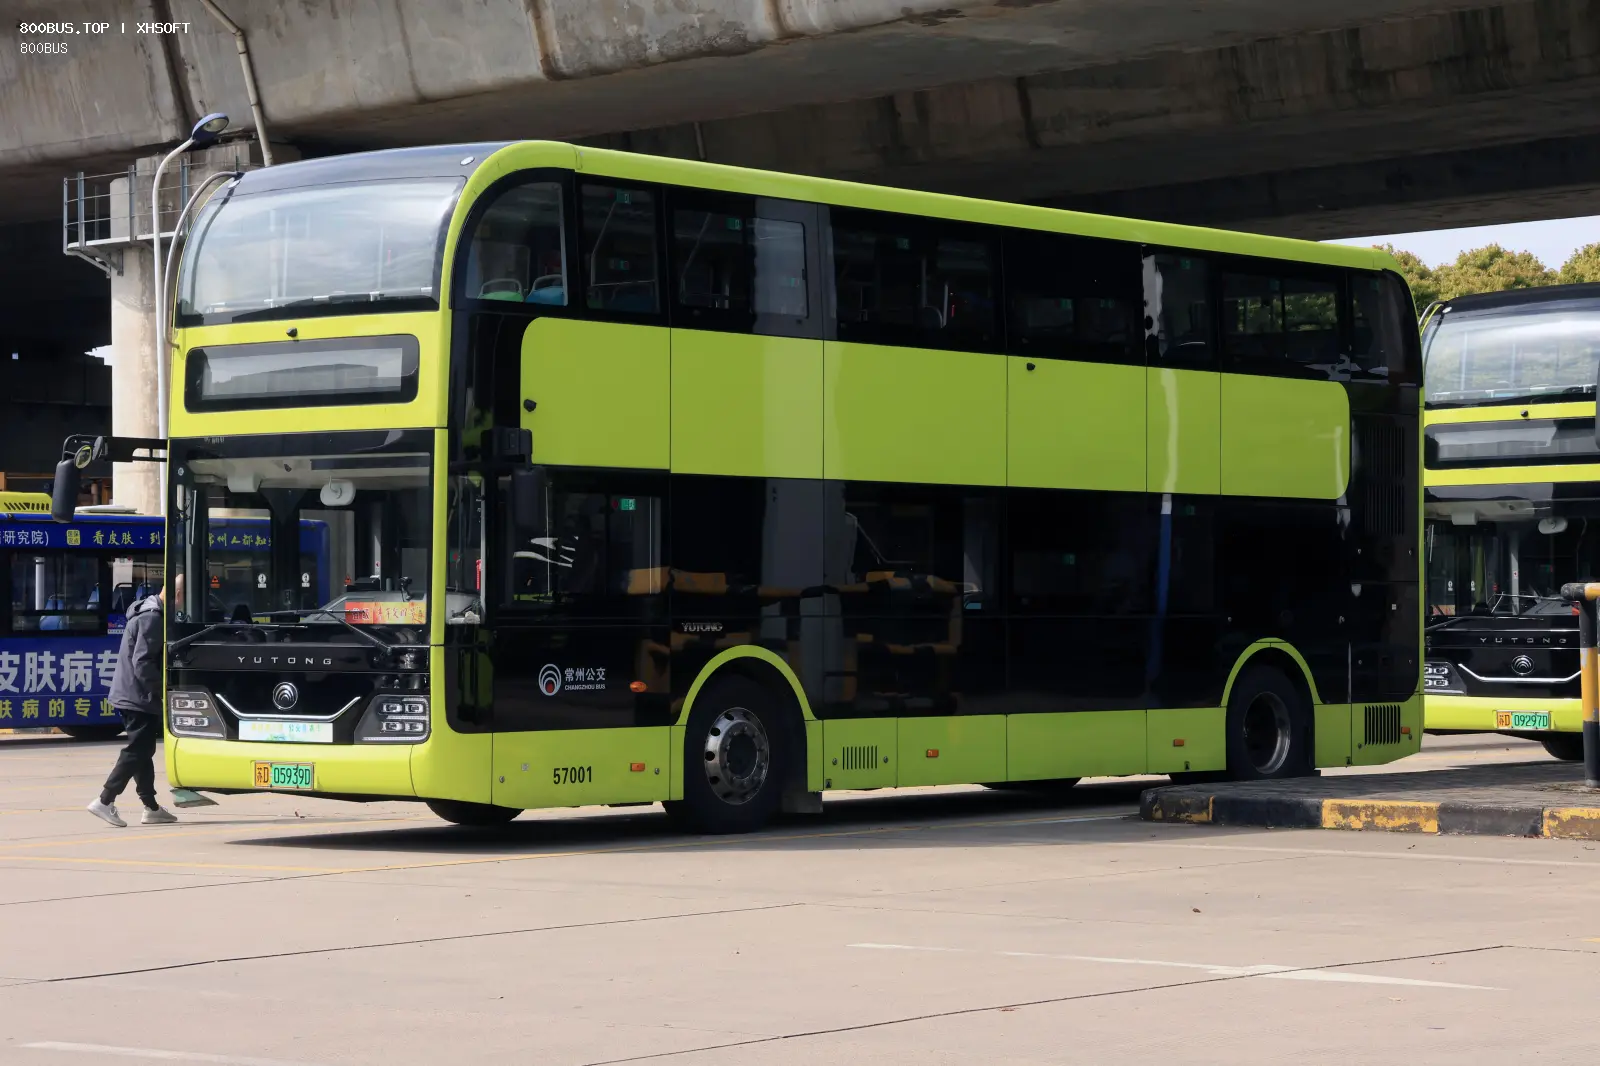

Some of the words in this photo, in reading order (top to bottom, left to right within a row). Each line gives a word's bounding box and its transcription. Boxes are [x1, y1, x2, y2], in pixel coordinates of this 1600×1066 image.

[0, 530, 49, 546] 研究院)
[93, 530, 166, 546] 看皮肤·到
[681, 622, 723, 632] YUTONG
[237, 656, 332, 666] YUTONG
[0, 650, 119, 693] 皮肤病专
[564, 667, 606, 682] 常州公交
[0, 698, 123, 719] 肤病的专业
[553, 765, 592, 785] 57001
